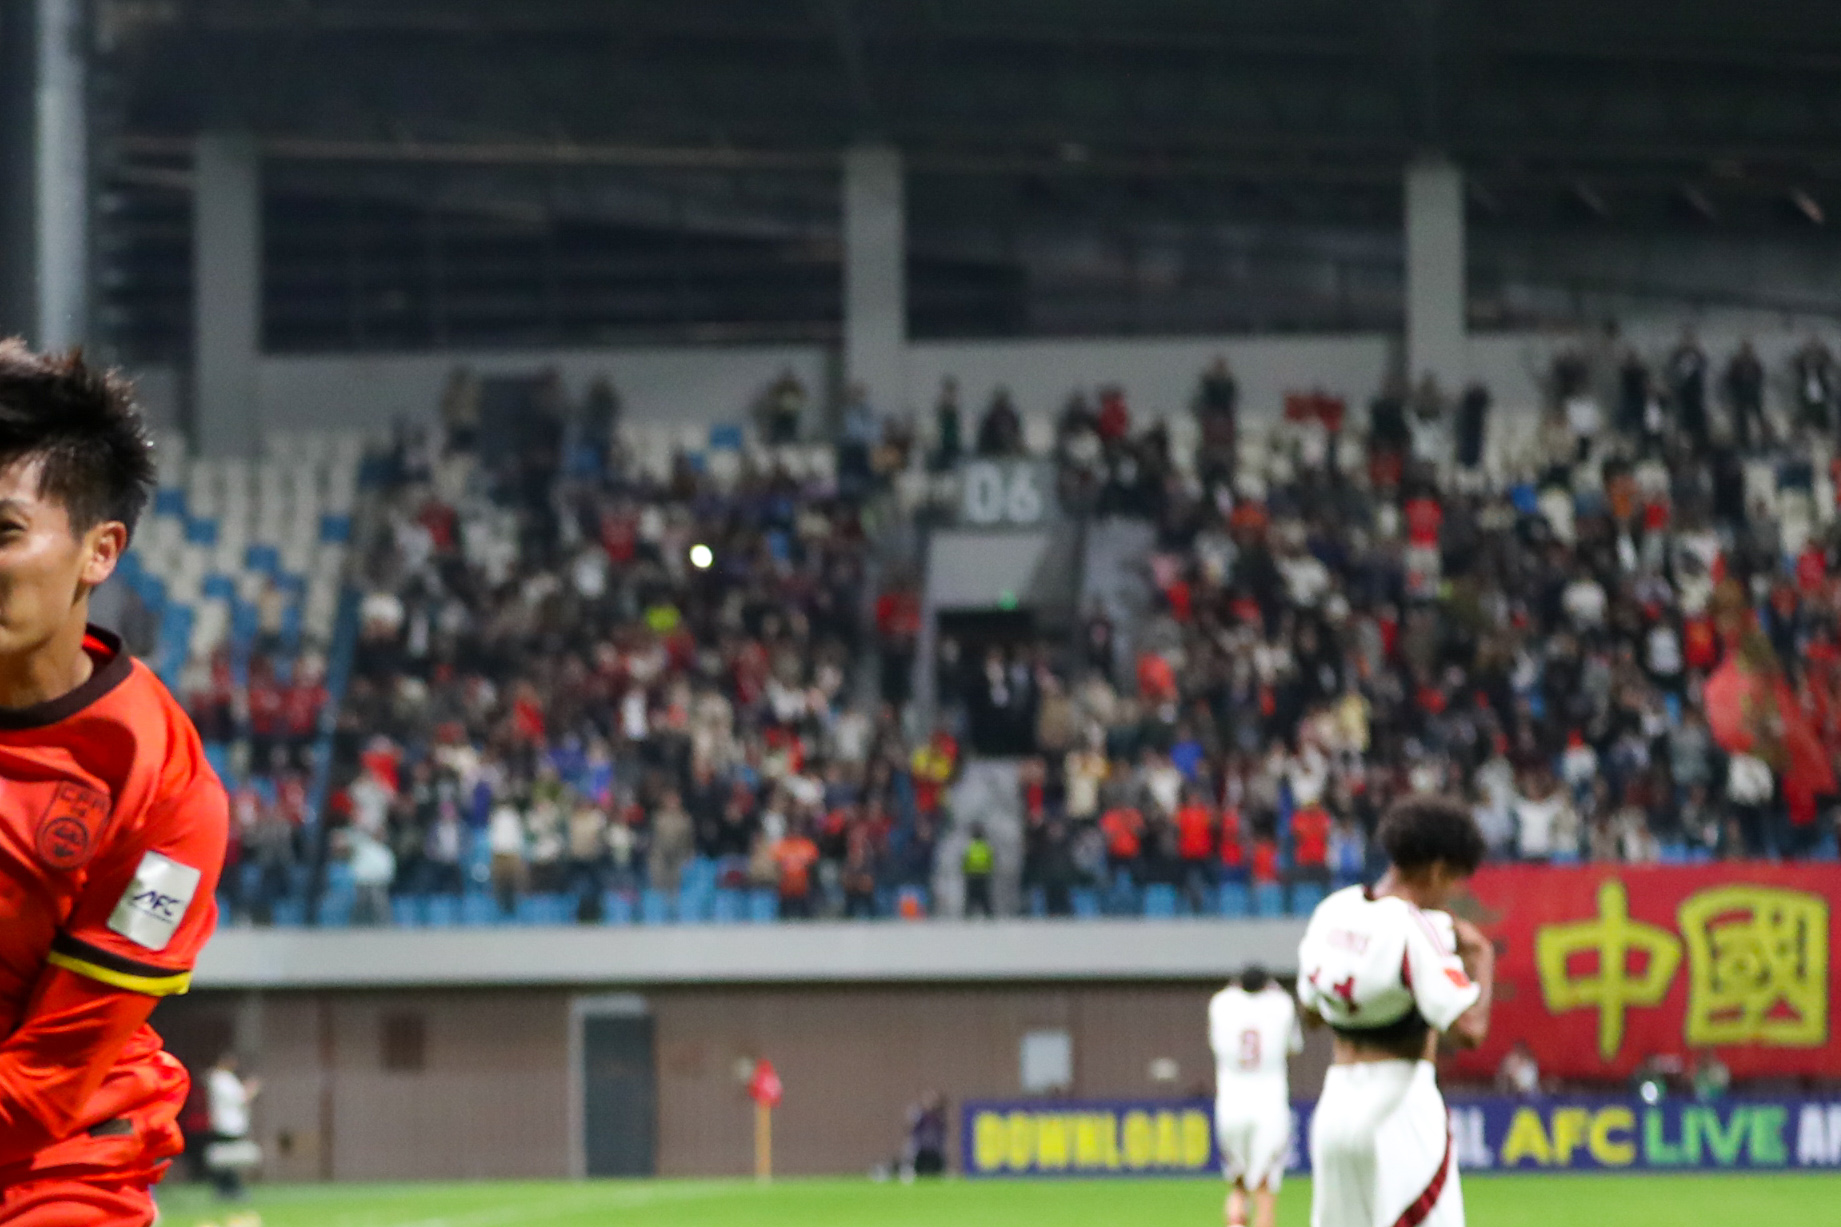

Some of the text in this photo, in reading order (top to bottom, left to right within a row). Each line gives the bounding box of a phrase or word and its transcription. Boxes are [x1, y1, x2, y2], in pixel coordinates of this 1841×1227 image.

[965, 460, 1041, 523] 06
[132, 890, 180, 917] AFC
[1536, 877, 1829, 1063] 中國
[973, 1111, 1209, 1169] DOWNLOAD
[1501, 1104, 1636, 1166] AFC
[1643, 1104, 1787, 1165] LIVE
